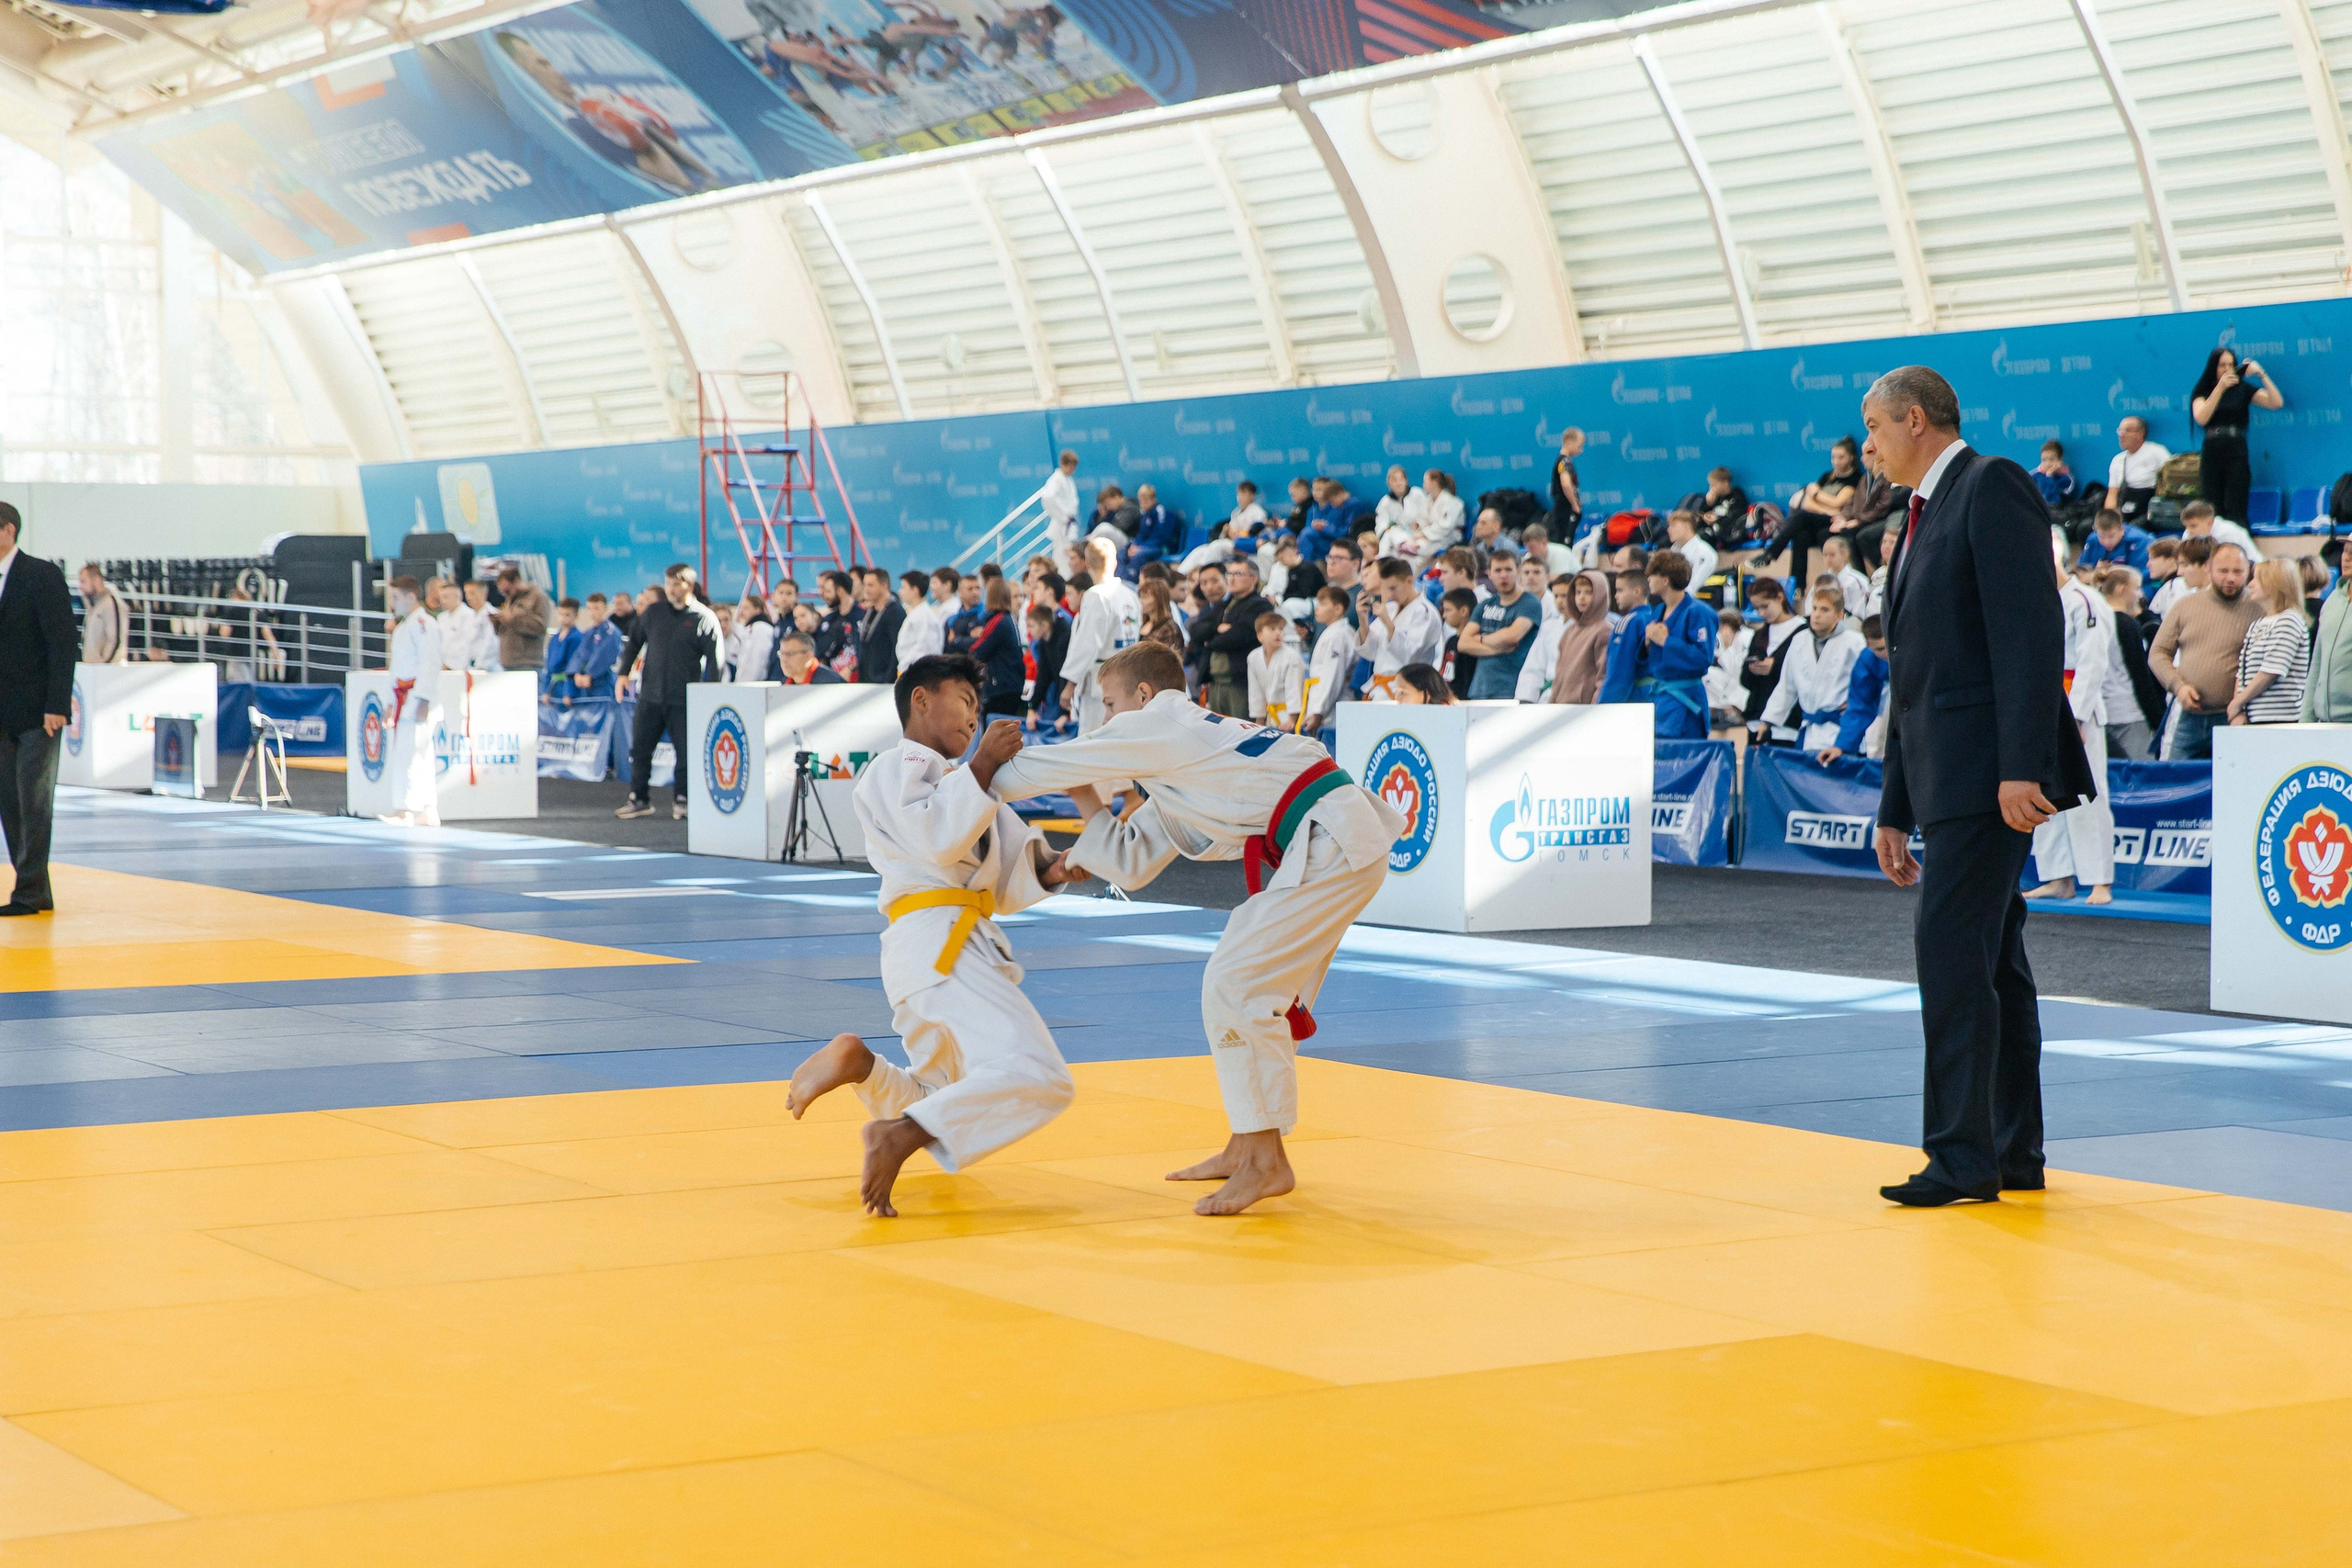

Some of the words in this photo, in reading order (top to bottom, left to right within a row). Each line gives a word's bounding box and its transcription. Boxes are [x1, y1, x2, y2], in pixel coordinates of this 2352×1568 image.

[342, 150, 532, 217] ПОБЕЖДАТЬ
[1364, 740, 1389, 791] РАЦИЯ
[1391, 736, 1428, 768] ДЗЮДО
[1423, 768, 1439, 843] РОССИИ
[1538, 796, 1630, 826] ГАЗПРОМ
[1652, 808, 1686, 827] INE
[2155, 817, 2212, 829] www.start-line
[1539, 829, 1630, 845] ТРАНСГАЗ
[1792, 818, 1862, 842] START
[2259, 778, 2302, 908] ФЕДЕРАЦИЯ
[2306, 771, 2352, 803] ДЗЮД
[2153, 836, 2210, 860] LINE
[2301, 922, 2342, 944] ФДР
[1217, 1040, 1247, 1049] adidas
